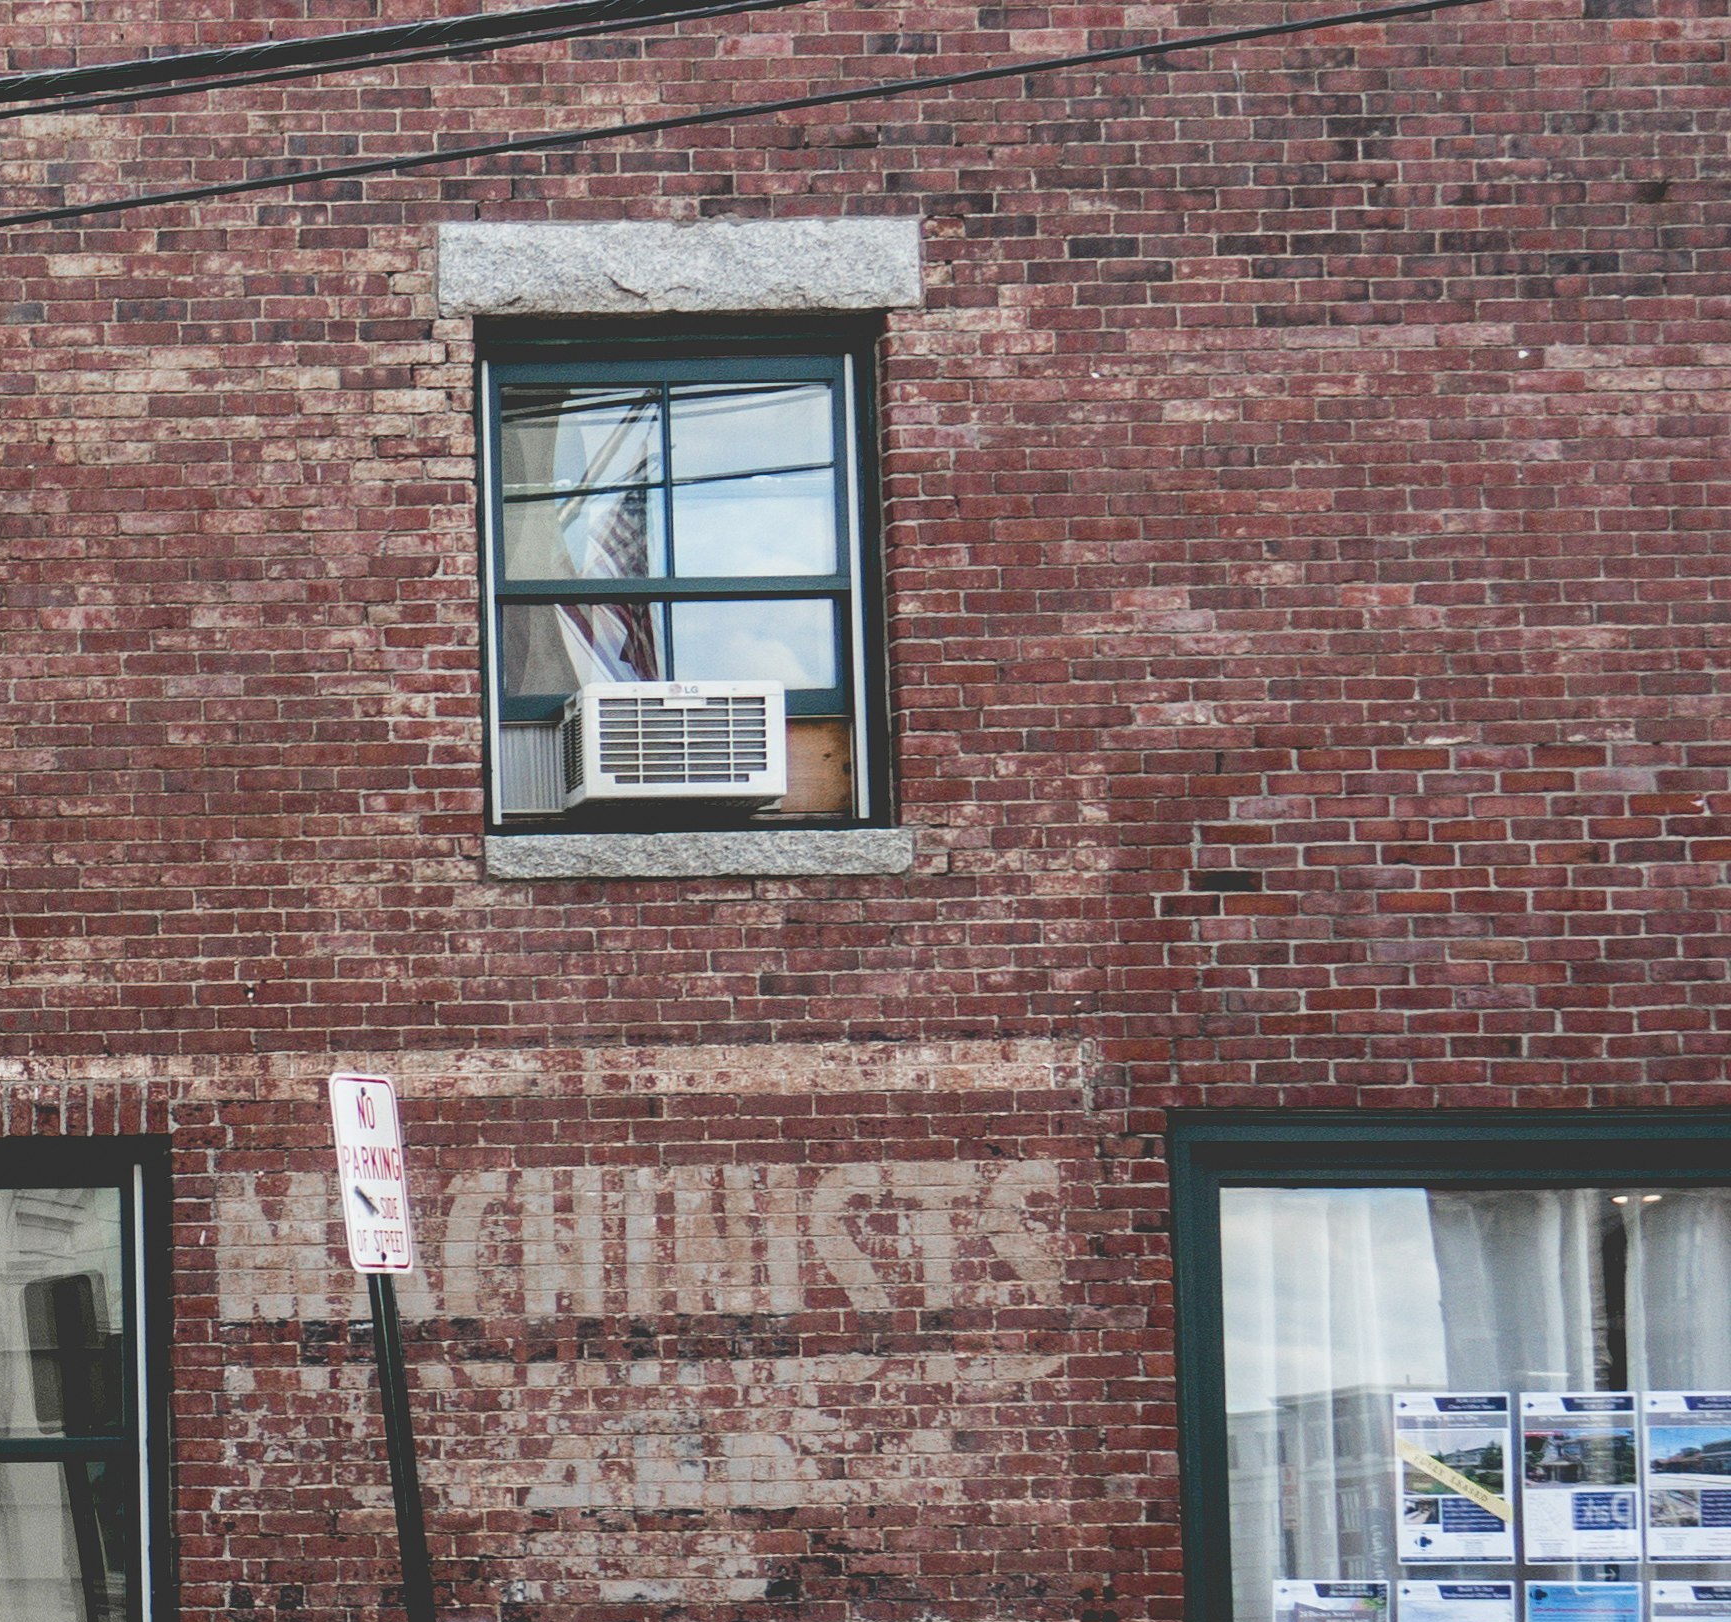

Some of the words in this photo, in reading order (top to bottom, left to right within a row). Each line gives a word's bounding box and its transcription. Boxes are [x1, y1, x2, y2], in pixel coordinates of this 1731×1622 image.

[684, 685, 698, 694] LG
[355, 1094, 375, 1129] NO
[342, 1145, 400, 1181] PARKING
